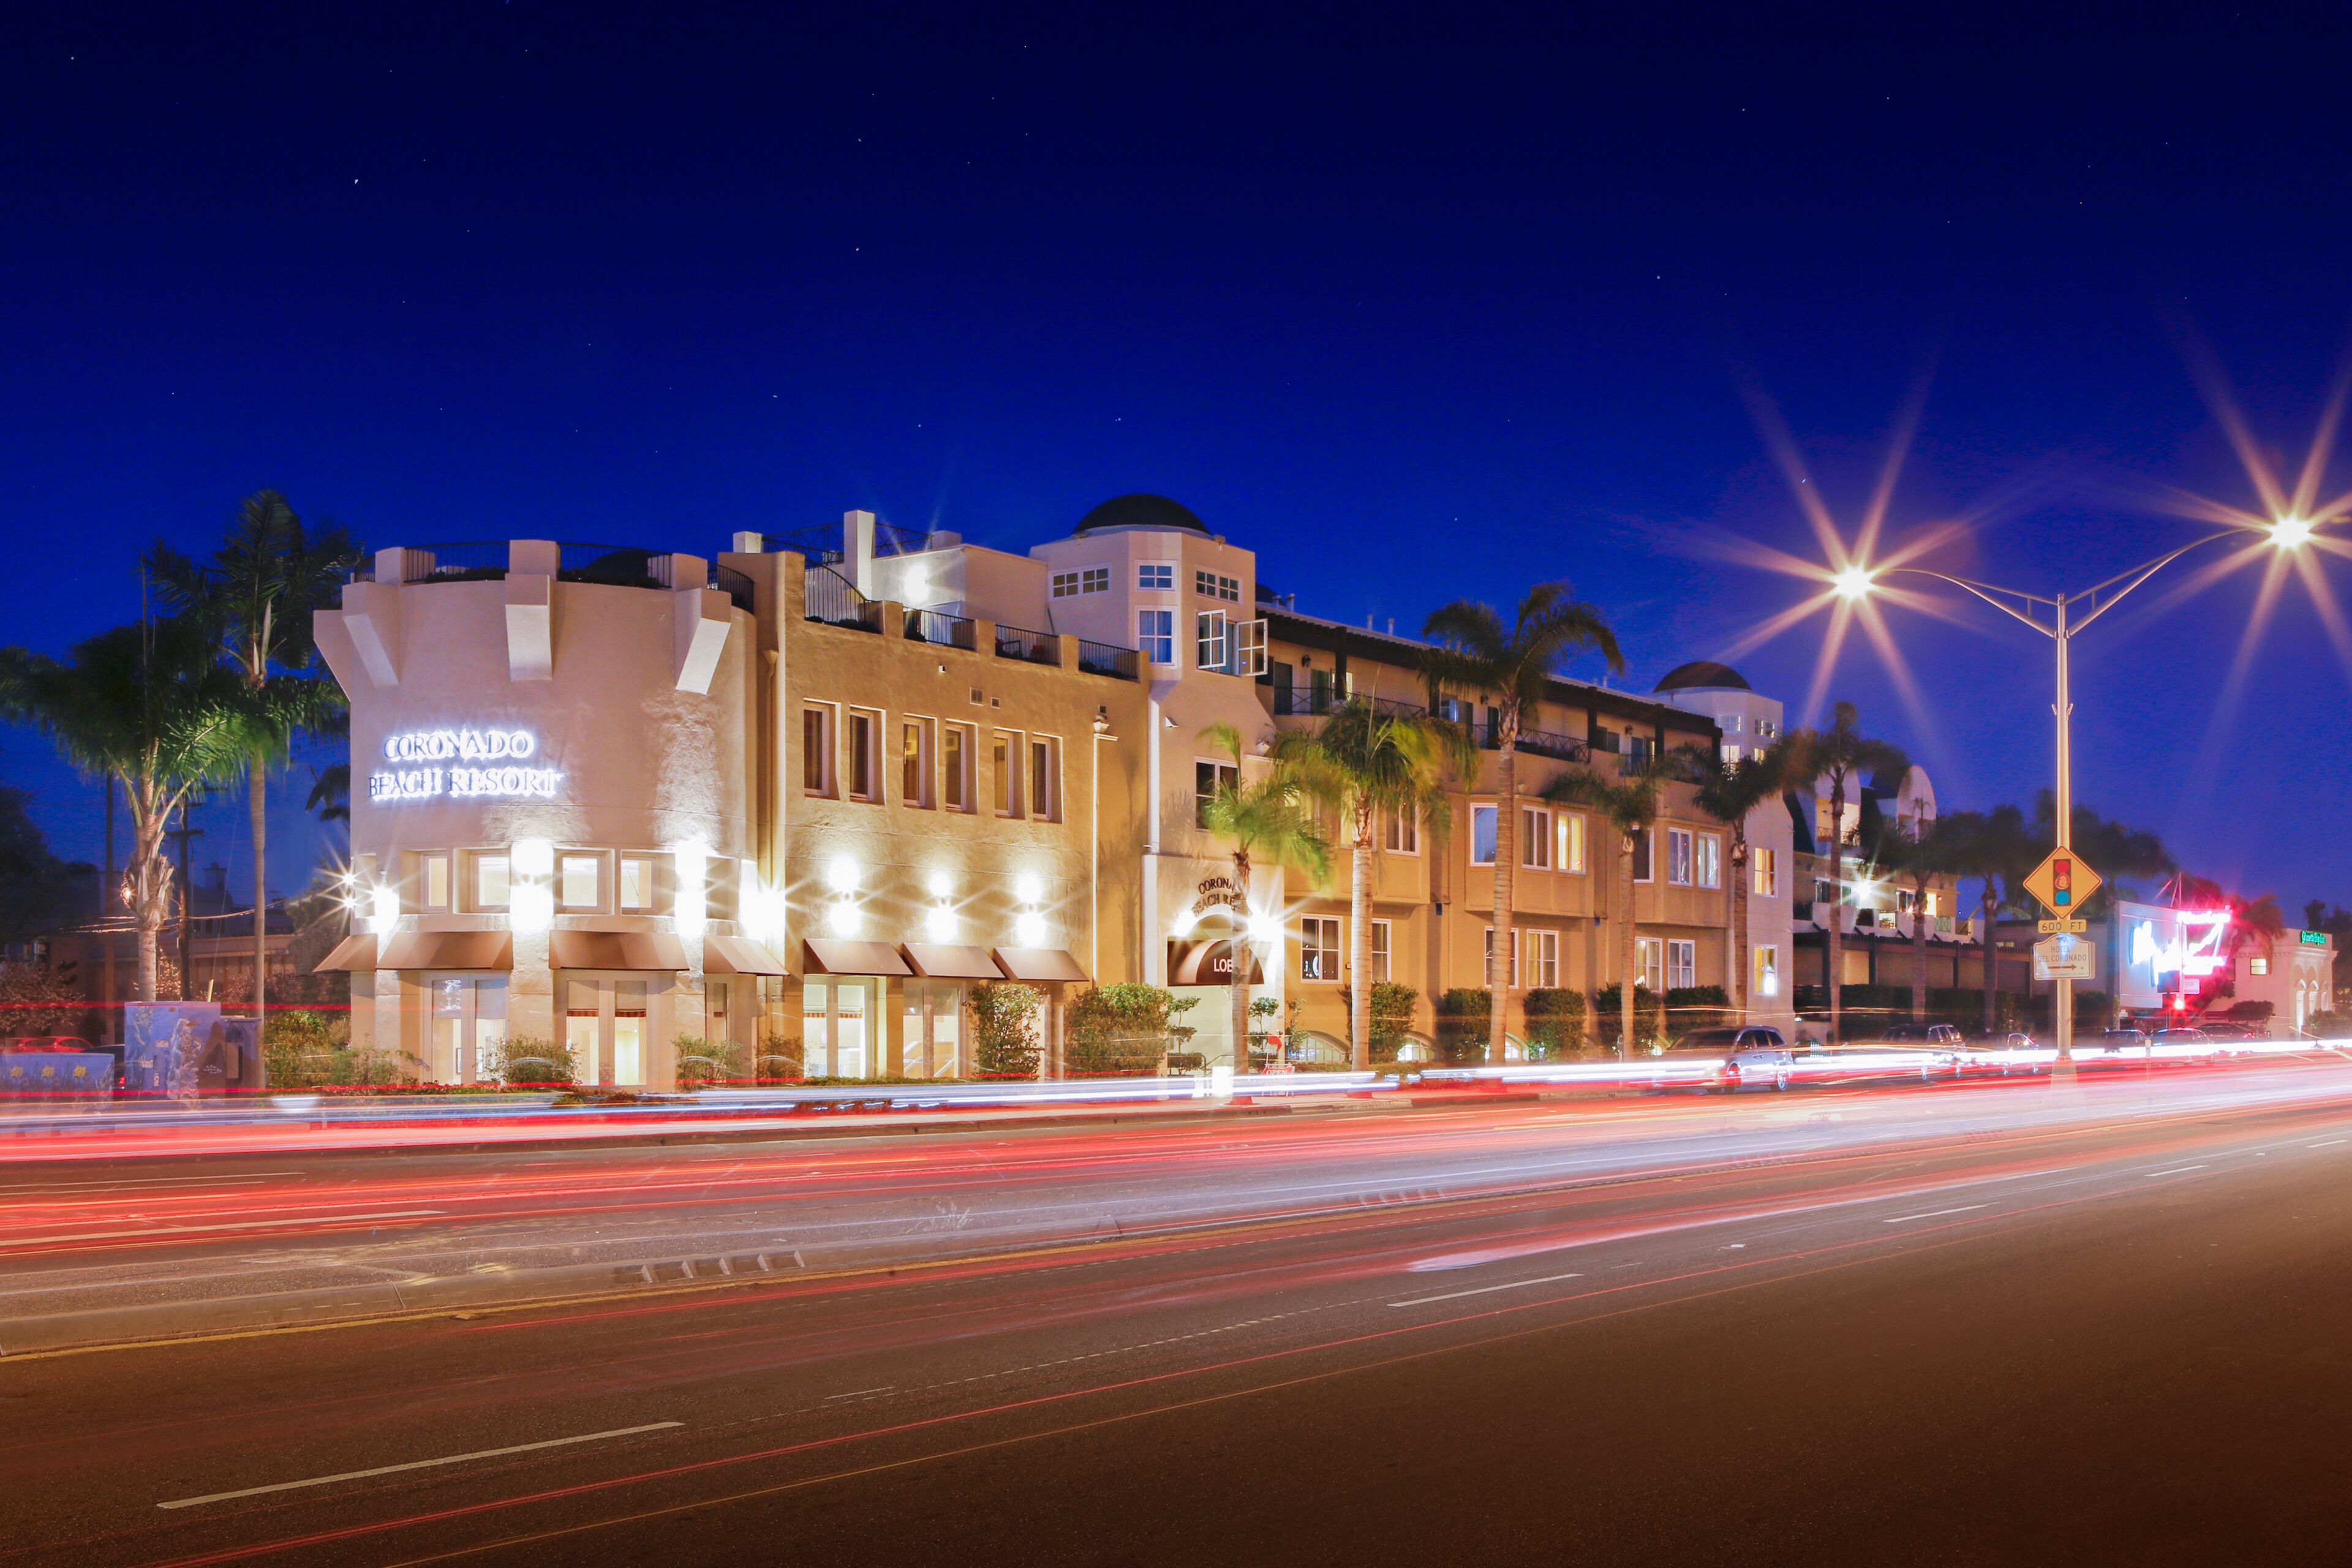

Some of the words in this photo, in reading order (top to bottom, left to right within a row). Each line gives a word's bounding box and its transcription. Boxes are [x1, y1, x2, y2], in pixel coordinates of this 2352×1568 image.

[383, 733, 529, 760] CORONADO
[368, 769, 439, 797] BEACH
[447, 767, 558, 794] RESORT
[2042, 922, 2062, 931] 600
[1214, 958, 1233, 973] LOB
